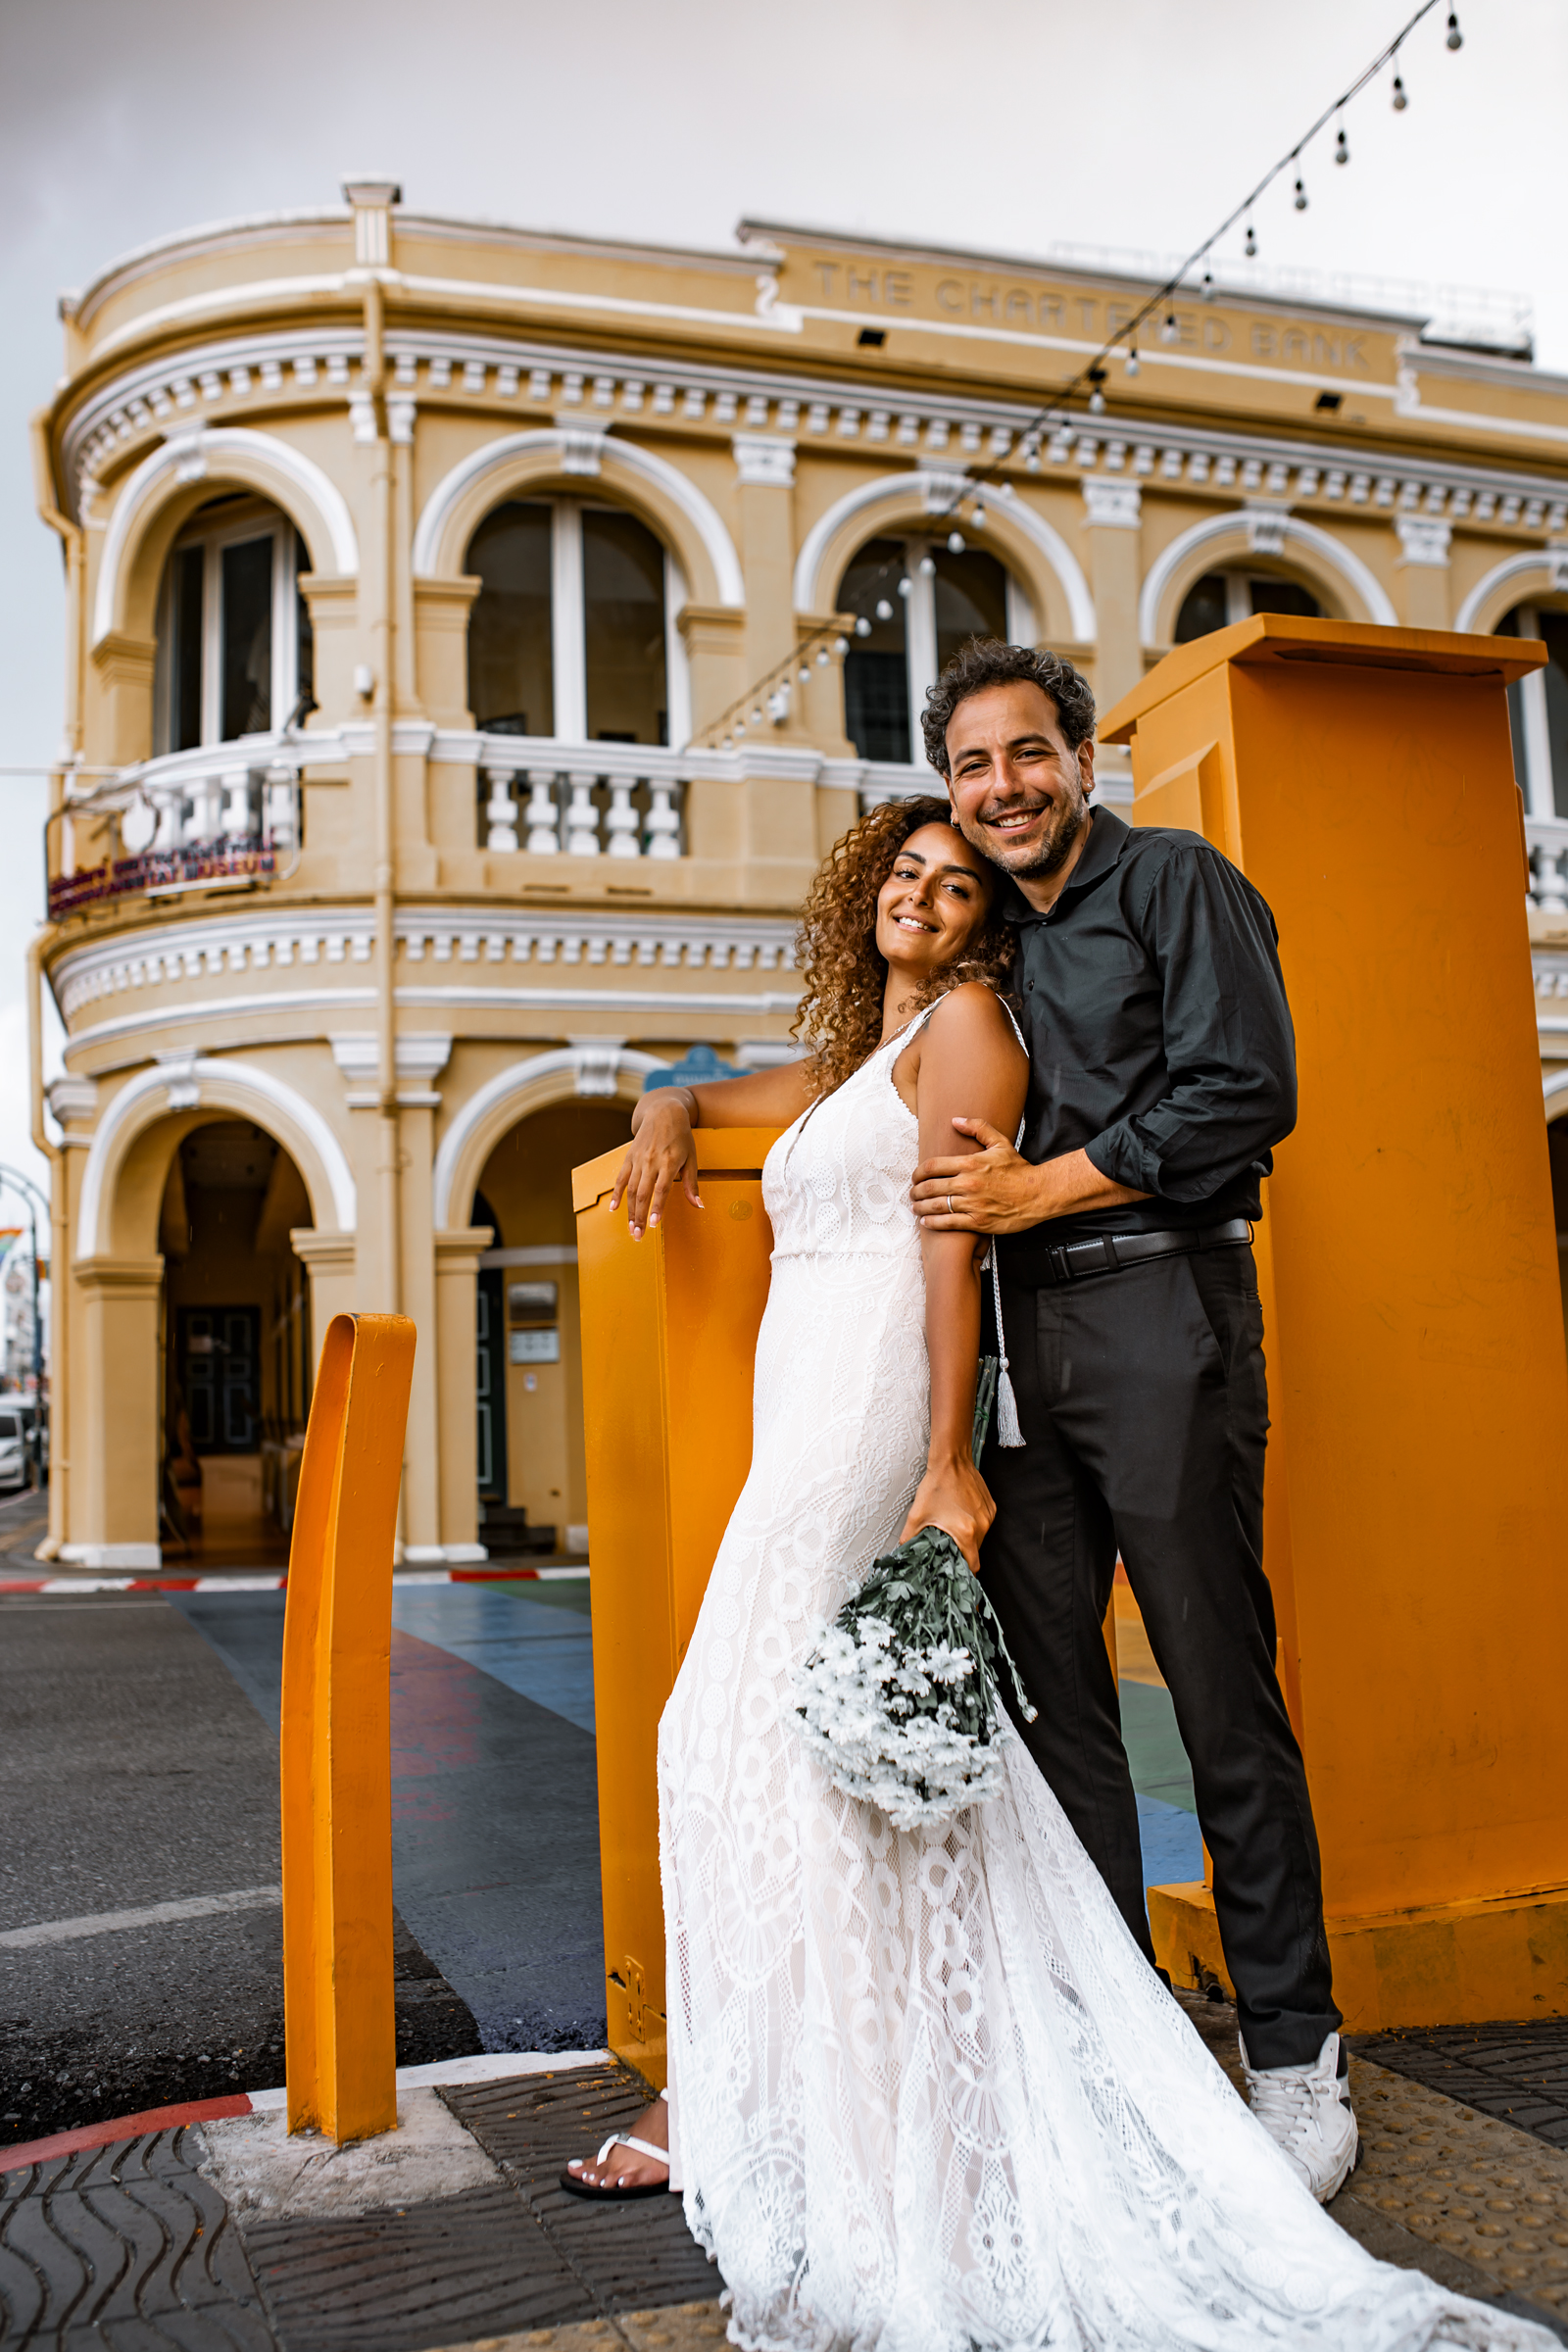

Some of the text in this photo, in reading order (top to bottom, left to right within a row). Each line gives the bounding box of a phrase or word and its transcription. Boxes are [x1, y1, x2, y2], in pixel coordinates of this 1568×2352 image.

[814, 261, 1370, 370] THE CHARTERED BANK
[184, 856, 275, 880] MUSEUM
